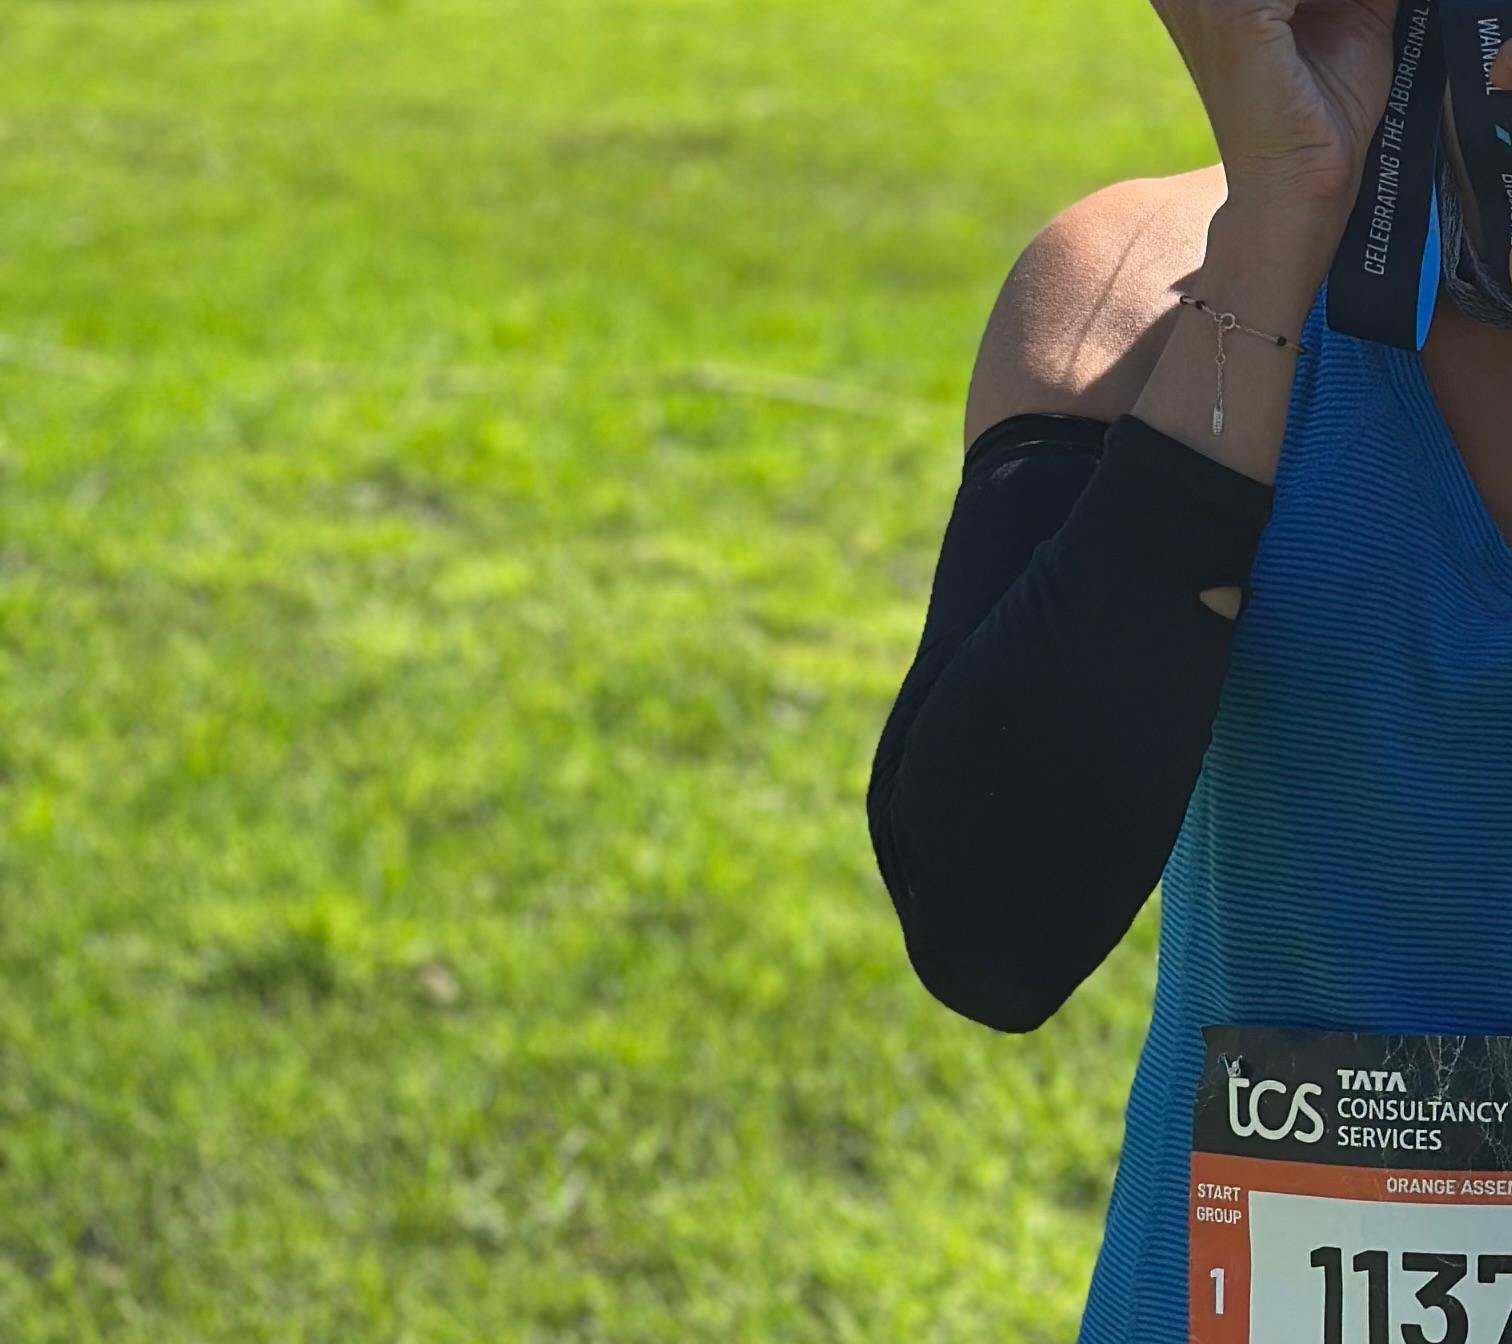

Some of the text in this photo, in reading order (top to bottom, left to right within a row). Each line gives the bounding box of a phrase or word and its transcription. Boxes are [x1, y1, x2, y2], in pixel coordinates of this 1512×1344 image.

[1387, 6, 1430, 116] ABORIGINAL
[1477, 17, 1502, 96] WANL
[1381, 114, 1405, 151] THE
[1364, 154, 1400, 275] CELEBRATING
[1336, 1069, 1407, 1093] TATA
[1229, 1075, 1325, 1144] tcs
[1336, 1097, 1509, 1123] CONSULTANCY
[1336, 1125, 1443, 1151] SERVICES
[1197, 1183, 1241, 1202] START
[1386, 1177, 1457, 1195] ORANGE
[1196, 1206, 1242, 1224] GROUP
[1210, 1267, 1225, 1315] 1
